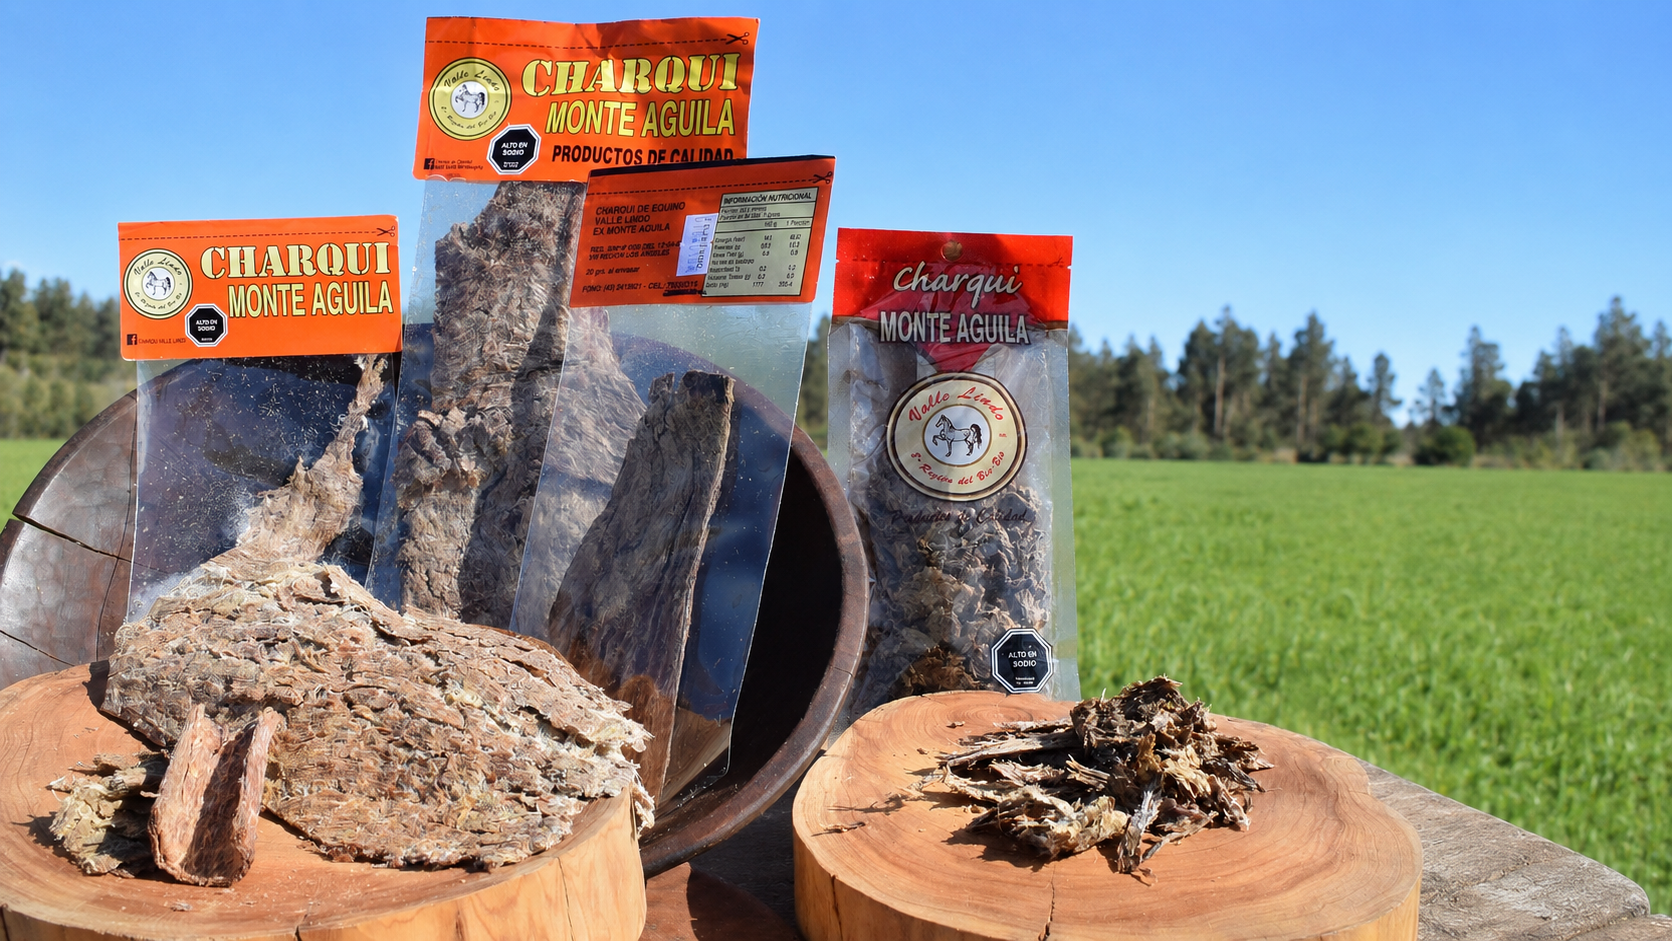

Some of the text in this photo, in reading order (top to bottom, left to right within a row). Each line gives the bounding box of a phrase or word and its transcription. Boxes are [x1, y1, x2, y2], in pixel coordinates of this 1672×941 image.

[521, 52, 741, 97] CHARQUI
[545, 98, 736, 138] MONTE AGUILA
[552, 145, 643, 165] PRODUCTOS
[595, 201, 686, 216] CHARQUI DE EQUINO
[595, 214, 650, 226] VALLE LINDO
[593, 223, 670, 236] EX MONTE AGUILA
[200, 241, 391, 279] CHARQUI
[893, 260, 1023, 309] Charqui
[227, 280, 394, 319] MONTE AGUILA
[879, 310, 1031, 345] MONTE AGUILA
[908, 386, 1004, 422] Valle Lindo
[957, 475, 974, 485] del
[1008, 651, 1027, 659] ALTO
[1013, 660, 1037, 668] SODIO
